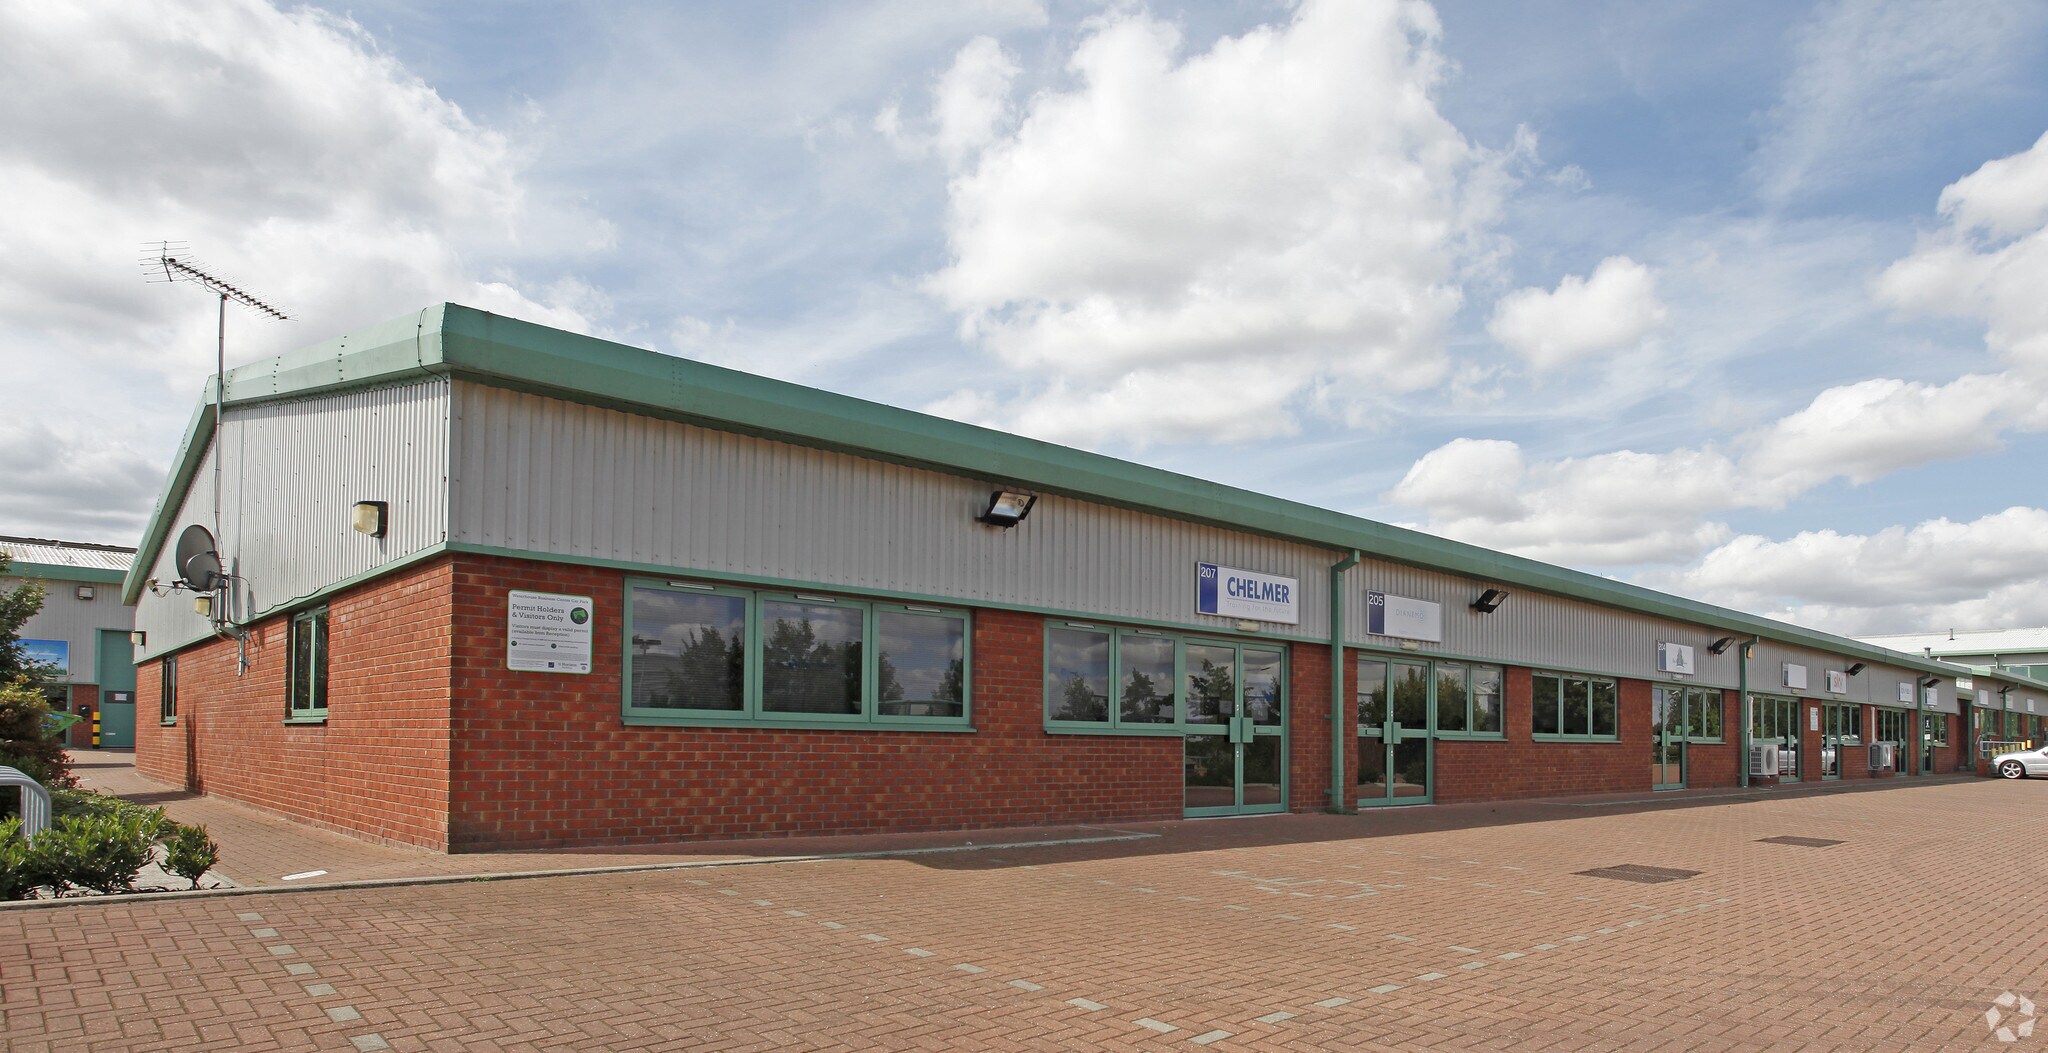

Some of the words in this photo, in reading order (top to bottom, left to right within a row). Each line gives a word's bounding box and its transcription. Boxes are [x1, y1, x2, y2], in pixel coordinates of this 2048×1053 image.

[1200, 566, 1216, 579] 207
[1226, 576, 1290, 604] CHELMER
[1369, 594, 1384, 606] 205
[537, 606, 565, 614] Holders
[1262, 605, 1272, 613] the
[518, 612, 546, 620] Visitors
[547, 614, 564, 622] Only
